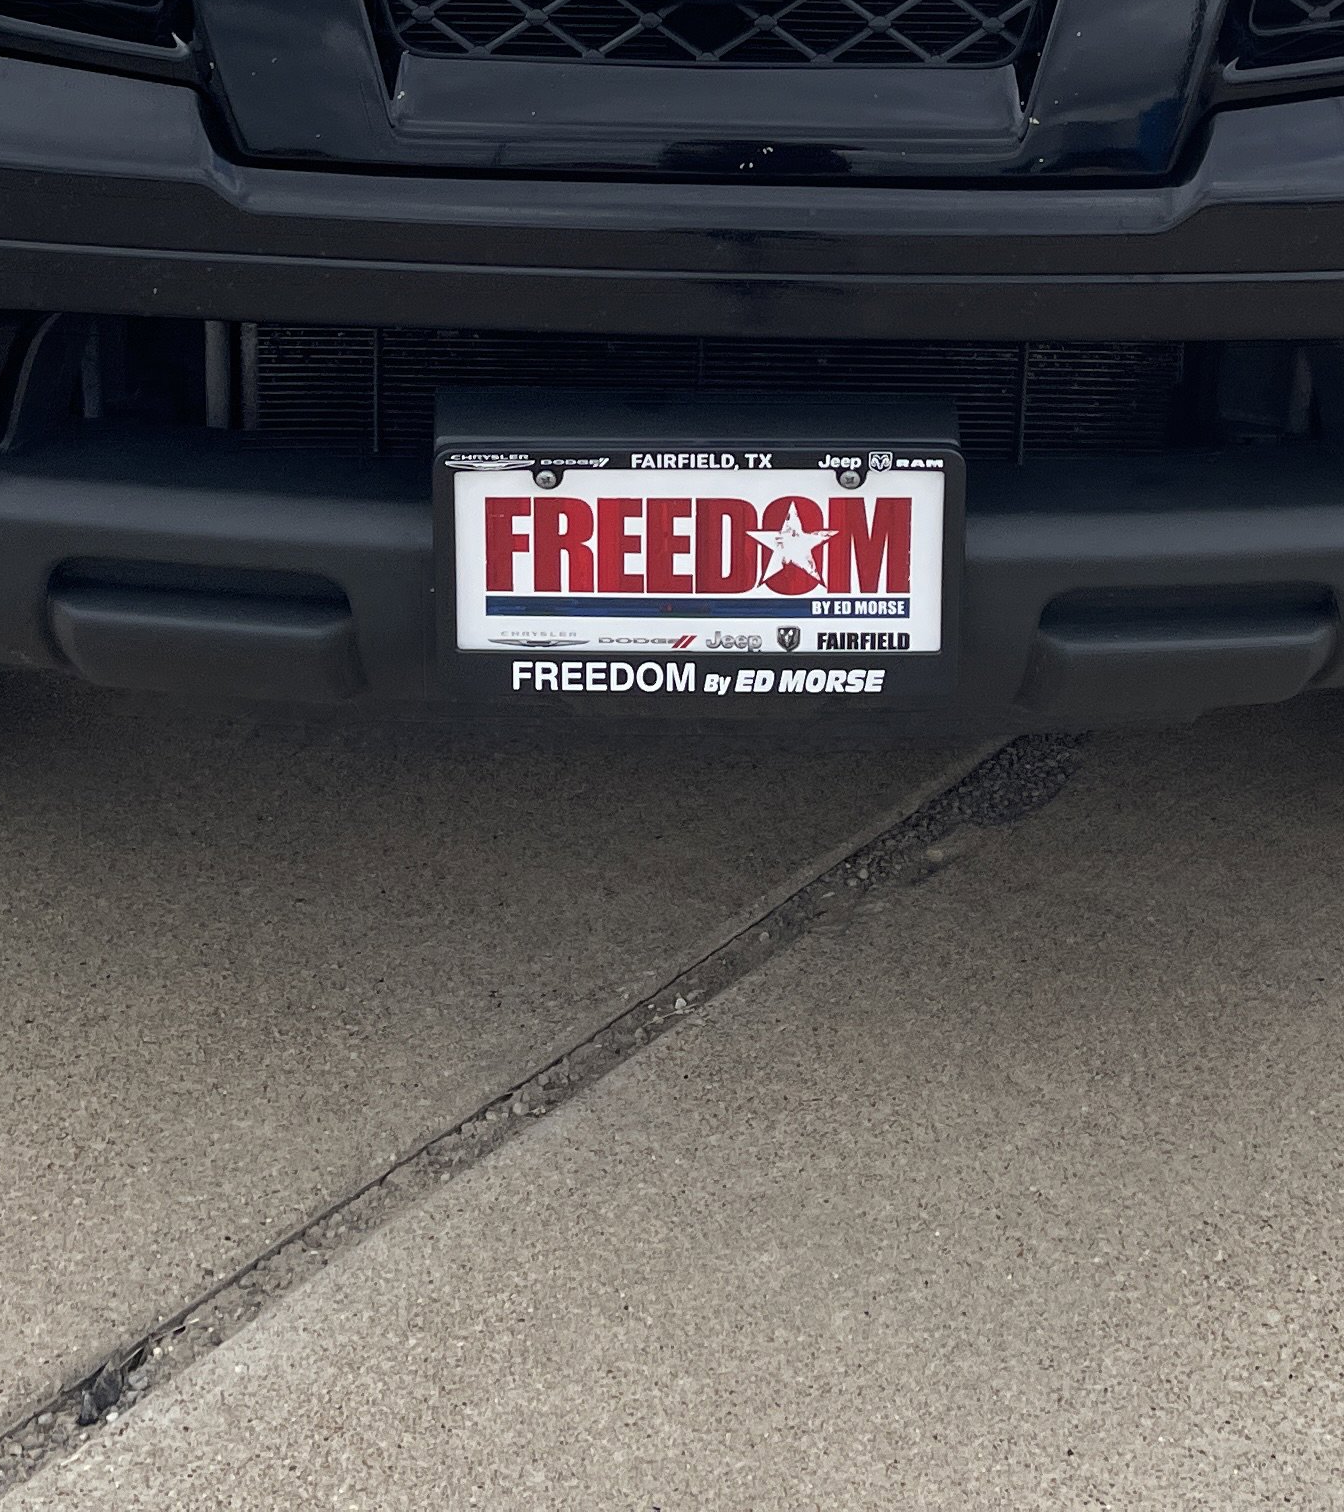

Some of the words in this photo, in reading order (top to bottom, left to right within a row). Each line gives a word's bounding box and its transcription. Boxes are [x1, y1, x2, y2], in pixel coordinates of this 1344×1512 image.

[450, 453, 529, 461] CHRYSLER
[630, 453, 740, 471] FAIRFIELD,
[744, 453, 773, 469] TX
[818, 454, 862, 470] Jeep
[895, 459, 944, 468] RAM
[484, 495, 913, 596] FREEDOM
[811, 600, 830, 615] BY
[833, 600, 852, 615] ED
[854, 600, 905, 616] MORSE
[706, 631, 763, 652] Jeep
[816, 632, 911, 651] FAIRFIELD
[512, 661, 696, 692] FREEDOM
[734, 669, 775, 693] ED
[778, 669, 886, 694] MORSE
